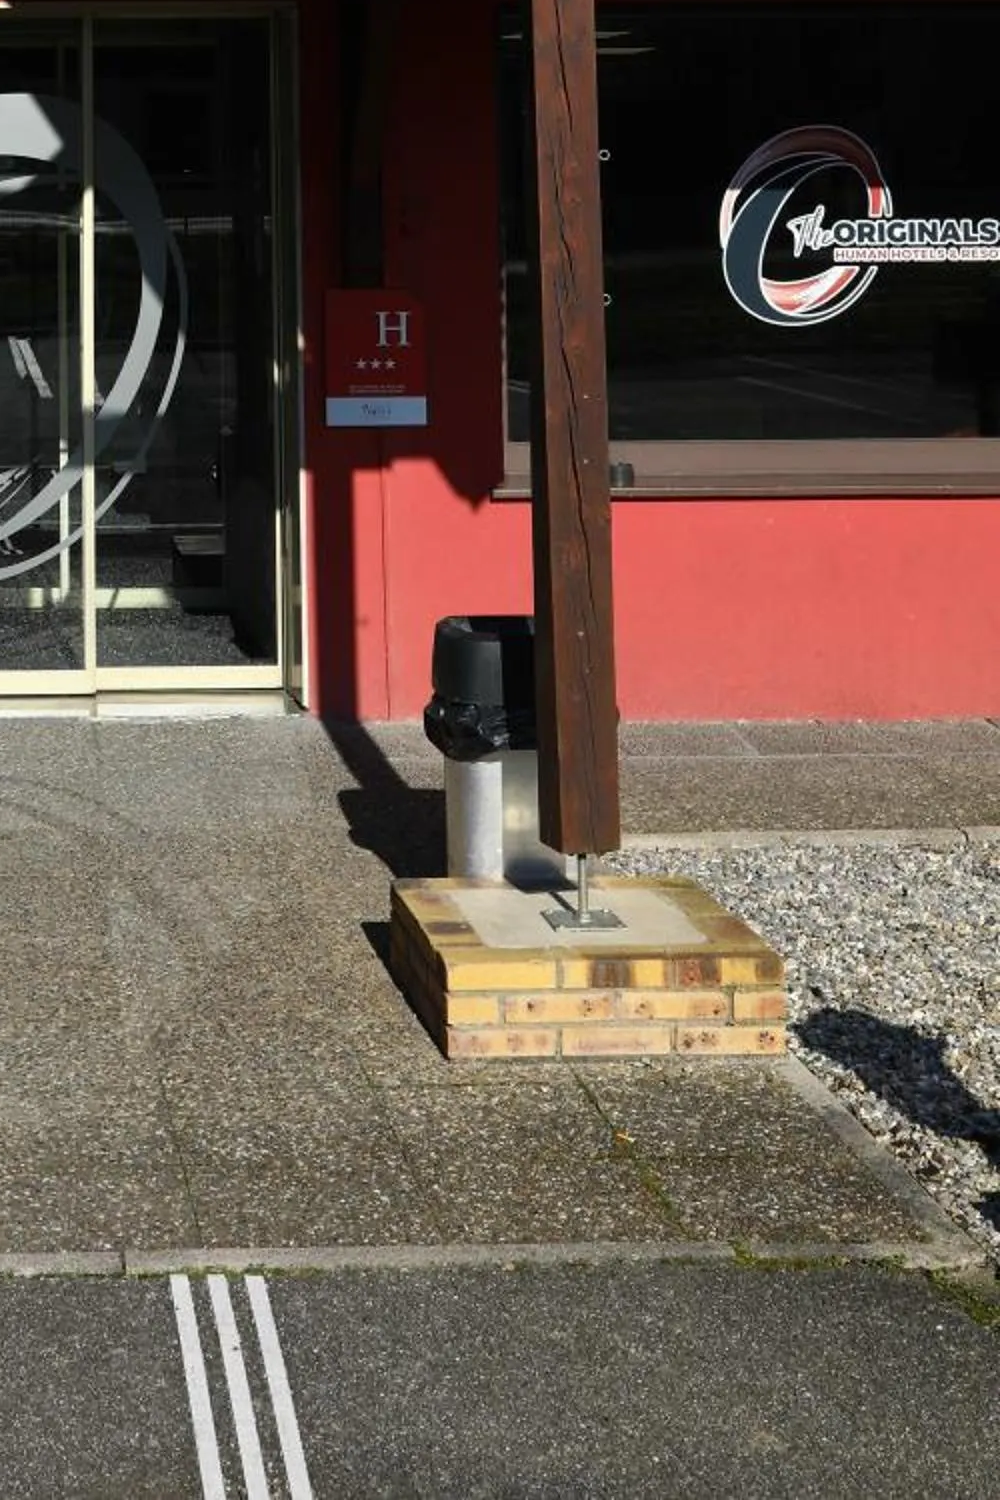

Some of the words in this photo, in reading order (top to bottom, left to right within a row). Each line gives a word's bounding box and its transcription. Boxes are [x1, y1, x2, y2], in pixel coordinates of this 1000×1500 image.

[786, 204, 833, 257] The
[832, 220, 998, 245] ORIGINALS
[834, 248, 889, 261] HUMAN
[890, 248, 946, 261] HOTELS
[376, 311, 411, 347] H
